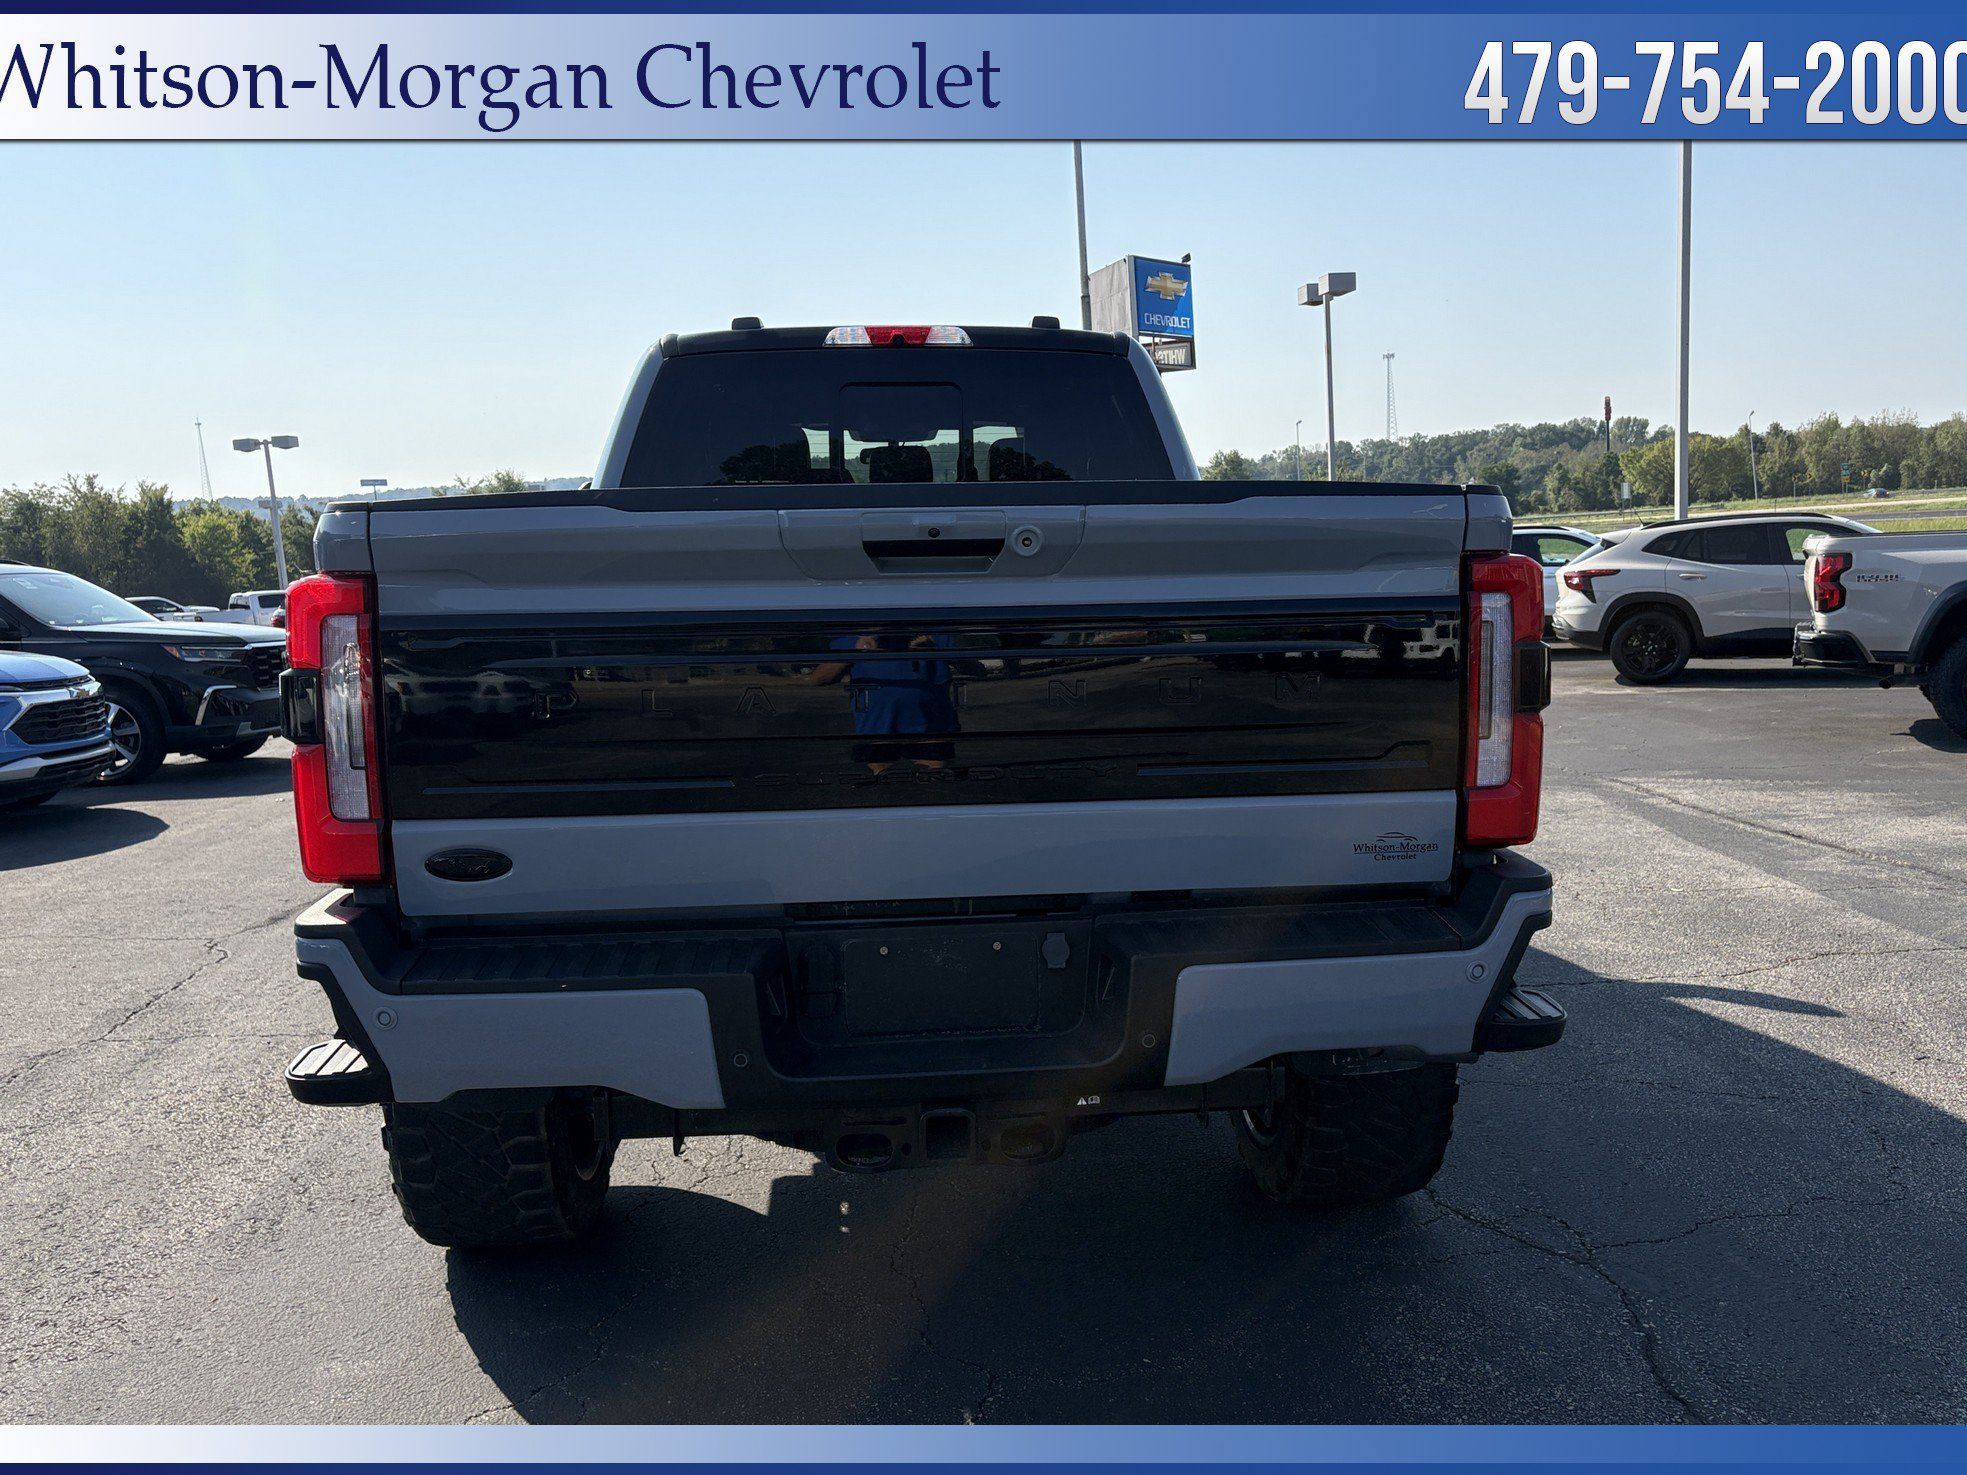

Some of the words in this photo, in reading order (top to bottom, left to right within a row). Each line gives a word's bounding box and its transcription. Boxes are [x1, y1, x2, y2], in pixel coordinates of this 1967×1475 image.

[1144, 312, 1191, 329] CHEVROLET
[532, 672, 1322, 720] PLATINUM
[1353, 842, 1438, 854] Whitson-Morgan
[1374, 853, 1417, 861] Chevrolet
